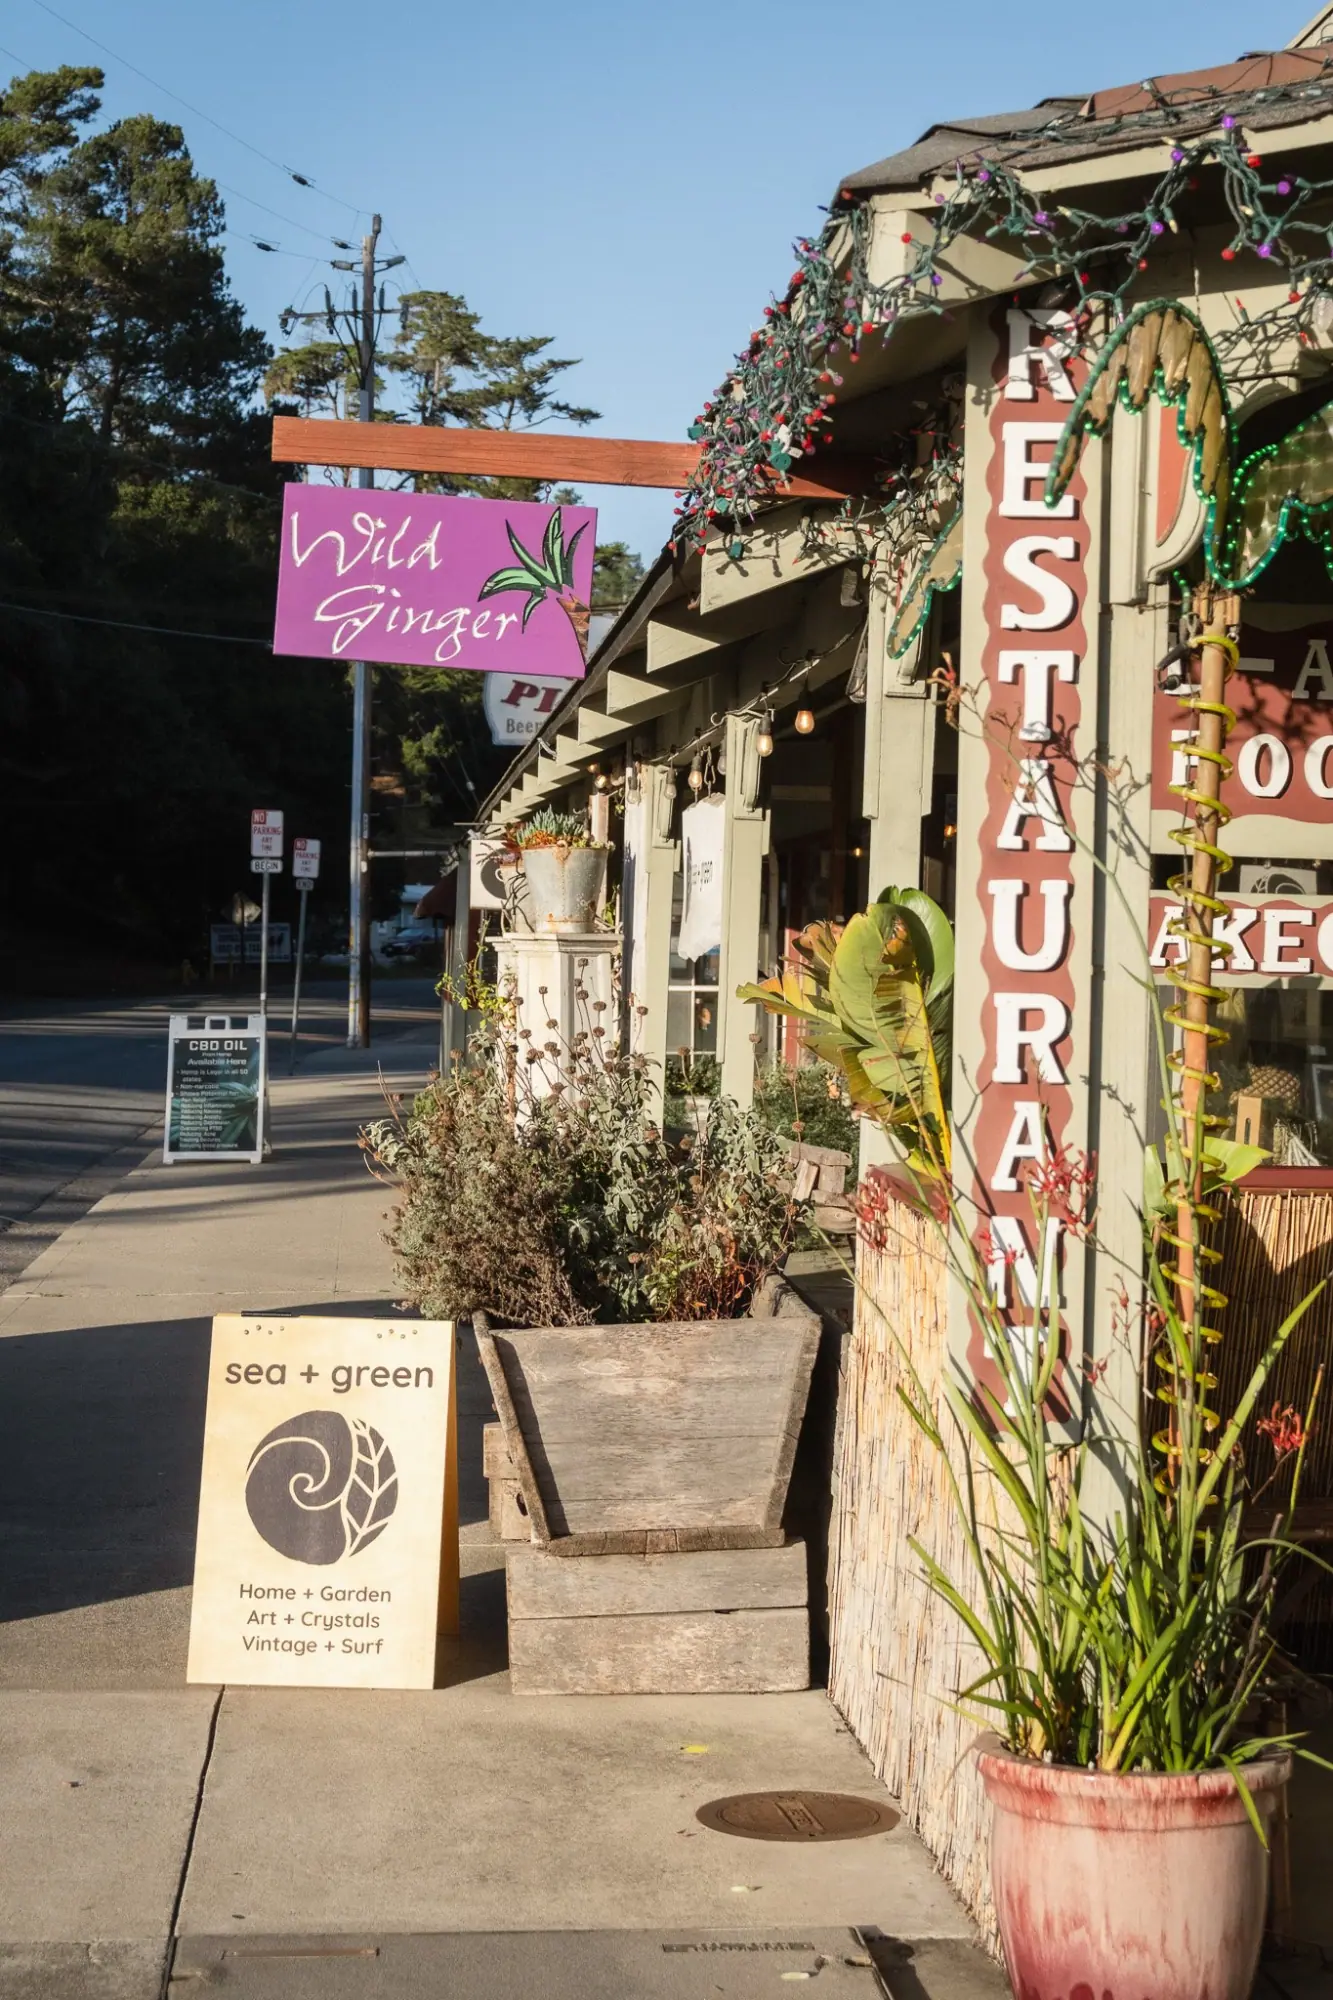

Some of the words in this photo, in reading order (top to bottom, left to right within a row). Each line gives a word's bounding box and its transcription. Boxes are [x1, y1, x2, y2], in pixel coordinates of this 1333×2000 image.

[290, 511, 442, 577] Wild
[313, 584, 518, 662] Ginger
[253, 812, 265, 823] NO
[253, 826, 281, 835] PARKING
[296, 840, 307, 850] NO
[295, 852, 320, 860] PARKING
[982, 308, 1079, 1418] RESTAURANT
[254, 862, 279, 871] BEGIN
[189, 1040, 219, 1051] CBD
[224, 1040, 247, 1051] OIL
[187, 1058, 225, 1066] Available
[226, 1058, 247, 1066] Here
[225, 1362, 287, 1385] sea
[299, 1364, 320, 1384] +
[331, 1365, 434, 1394] green
[239, 1583, 297, 1600] Home
[303, 1588, 315, 1600] +
[320, 1586, 392, 1602] Garden
[247, 1610, 277, 1626] Art
[283, 1613, 295, 1626] +
[301, 1610, 380, 1631] Crystals
[242, 1636, 318, 1656] Vintage
[324, 1640, 336, 1652] +
[341, 1638, 384, 1655] Surf
